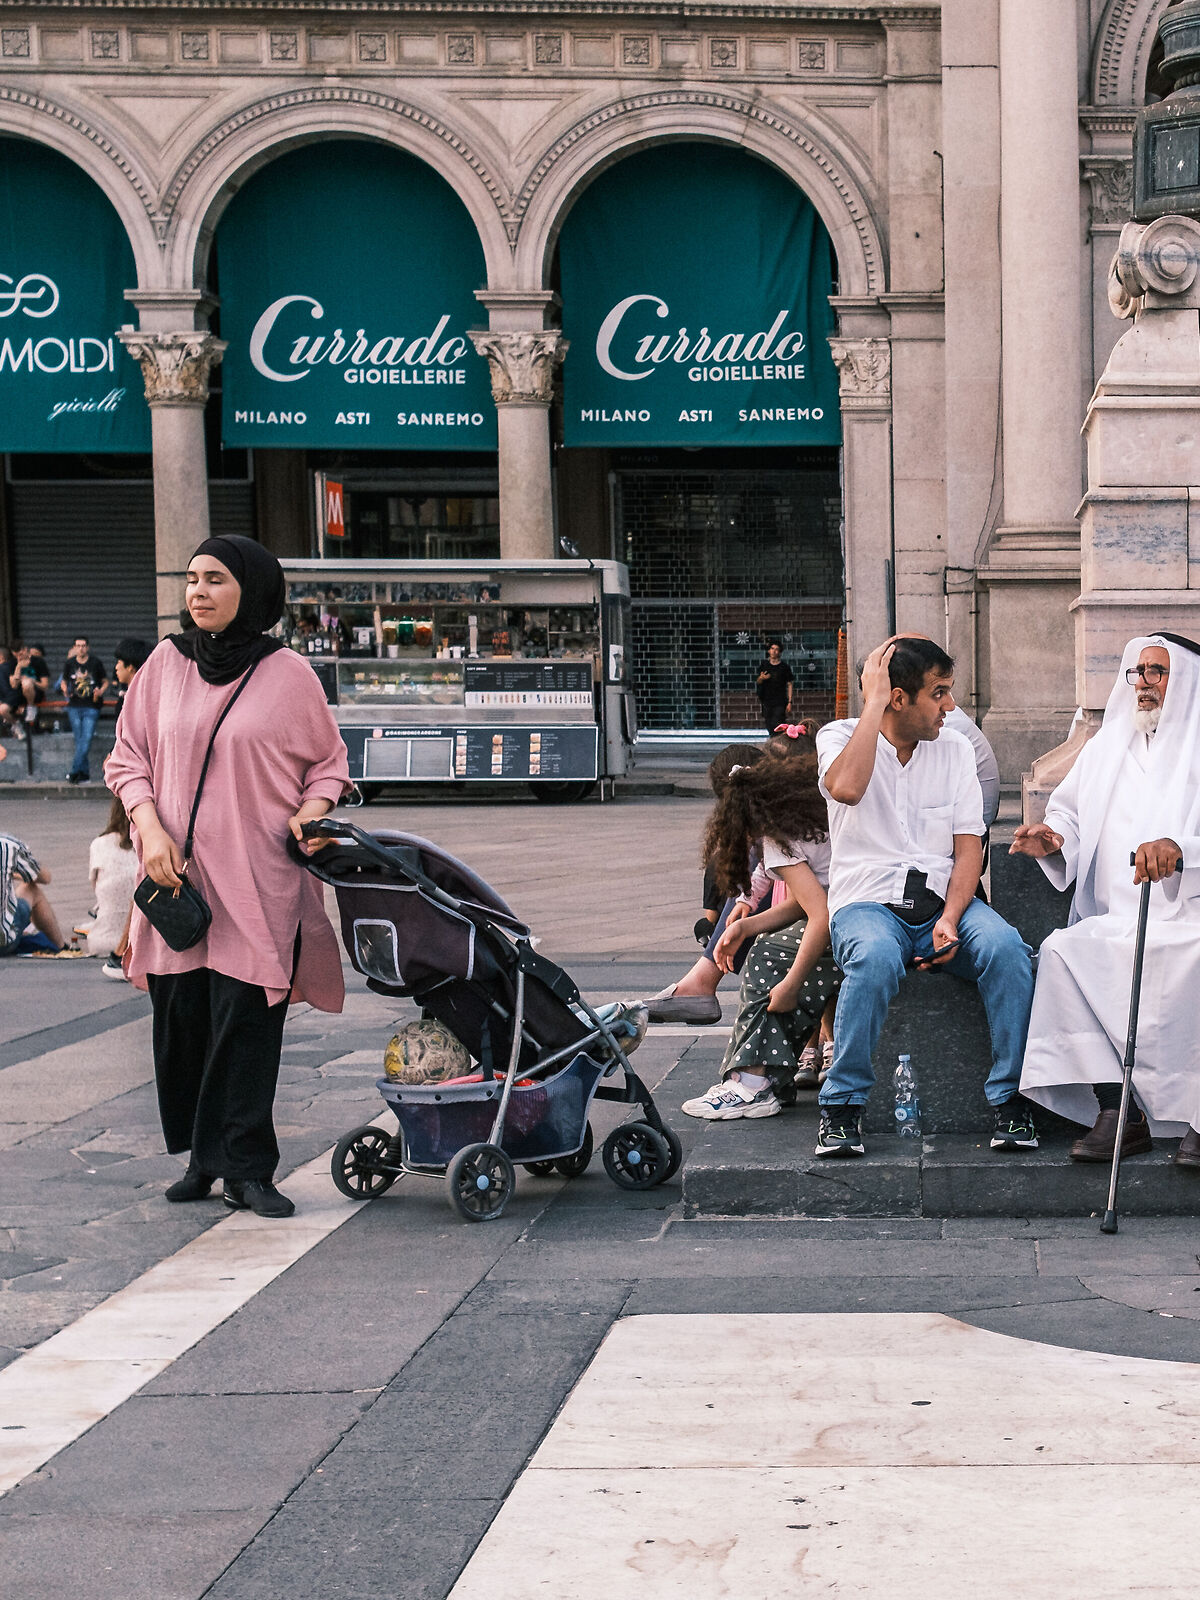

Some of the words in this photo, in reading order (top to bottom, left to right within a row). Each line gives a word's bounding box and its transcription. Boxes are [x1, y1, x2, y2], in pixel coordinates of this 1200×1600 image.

[249, 294, 468, 382] Currado
[596, 294, 806, 381] Currado
[343, 368, 466, 384] GIOIELLERIE
[688, 365, 805, 382] GIOIELLERIE
[47, 387, 126, 421] gioielli
[581, 409, 650, 422] MILANO
[679, 409, 713, 422] ASTI
[739, 407, 824, 421] SANREMO
[235, 410, 307, 424] MILANO
[335, 411, 370, 425] ASTI
[397, 412, 484, 426] SANREMO
[328, 490, 344, 525] M
